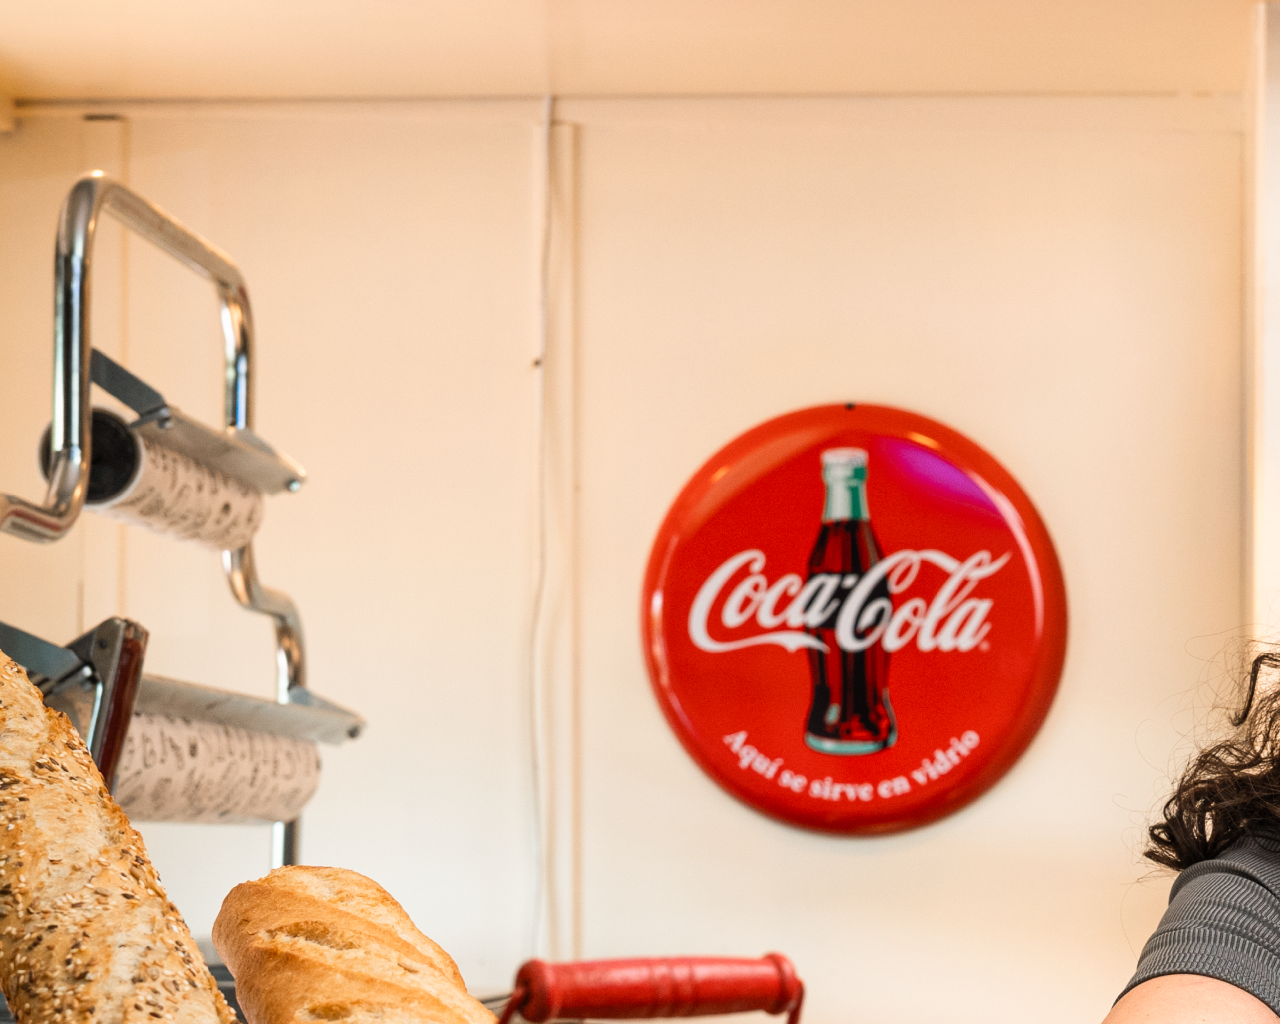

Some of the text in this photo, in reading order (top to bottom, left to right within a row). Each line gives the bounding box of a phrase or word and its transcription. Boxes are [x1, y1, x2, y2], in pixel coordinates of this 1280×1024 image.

[688, 548, 1012, 653] Coca-Cola
[723, 729, 981, 802] Aquí se sirve en vidrio
